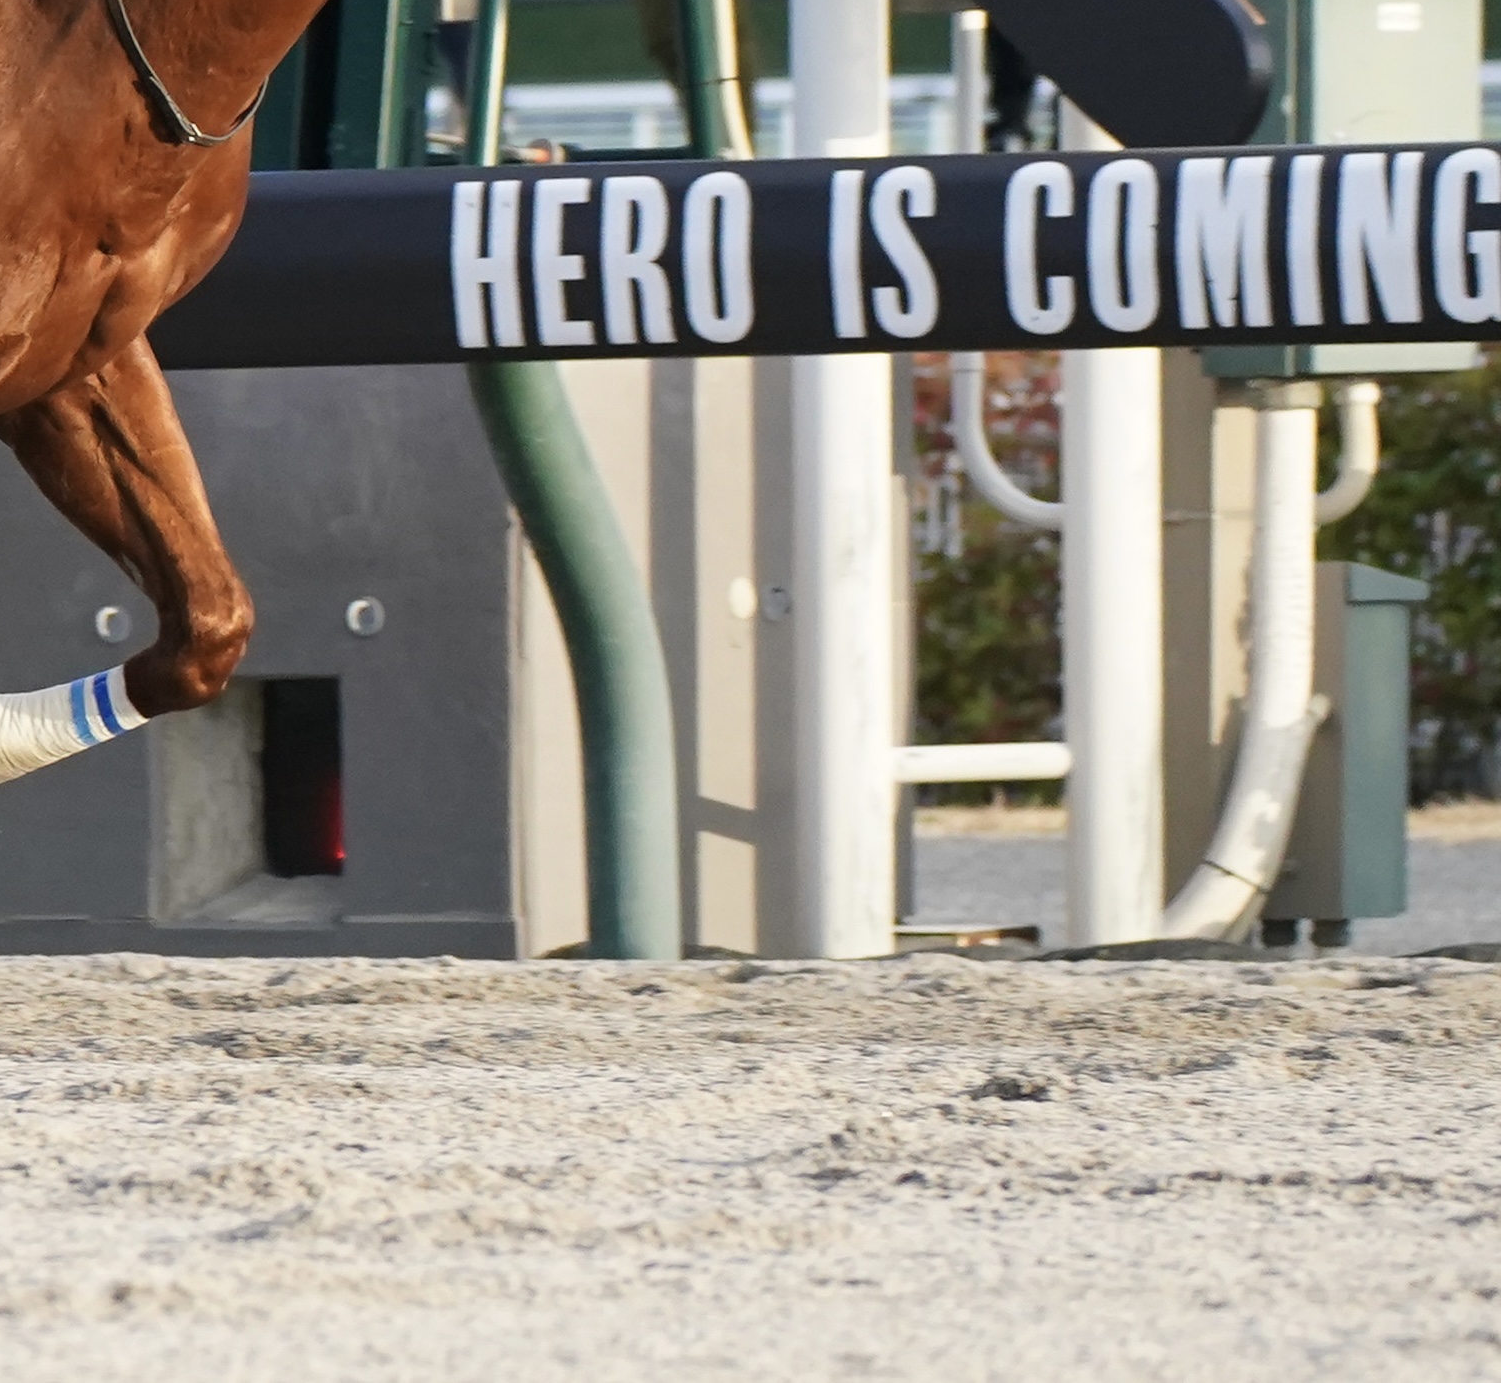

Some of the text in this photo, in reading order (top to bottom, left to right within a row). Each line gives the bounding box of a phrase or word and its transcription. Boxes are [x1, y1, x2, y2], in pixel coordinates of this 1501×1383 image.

[450, 147, 1501, 349] HERO IS COMING
